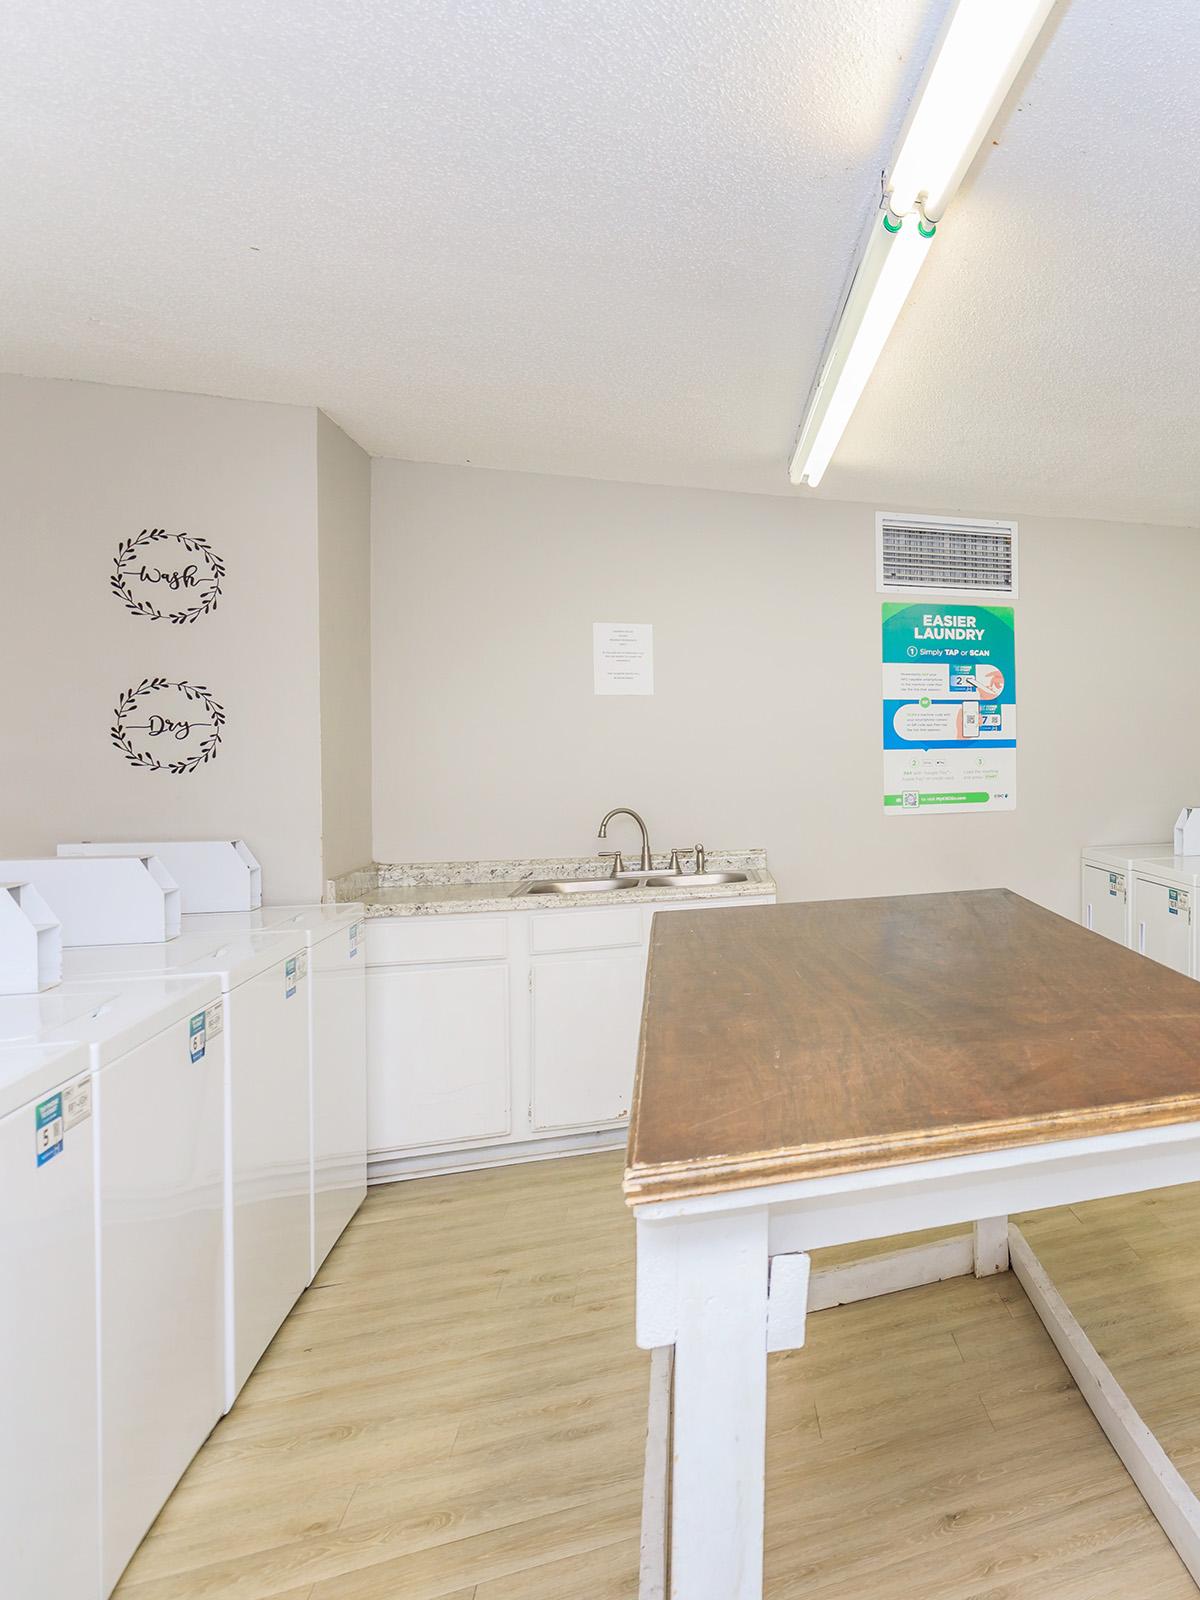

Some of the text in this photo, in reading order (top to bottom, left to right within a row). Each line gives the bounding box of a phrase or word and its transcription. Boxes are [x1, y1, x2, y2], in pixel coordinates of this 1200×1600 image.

[138, 564, 202, 590] Wash
[923, 614, 977, 628] EASIER
[914, 627, 985, 641] LAUNDRY
[920, 649, 943, 658] Simply
[944, 649, 959, 657] TAP
[969, 649, 990, 657] SCAN
[956, 677, 963, 685] 2
[145, 714, 196, 741] Dry
[982, 716, 988, 725] 7
[42, 1128, 50, 1147] 5
